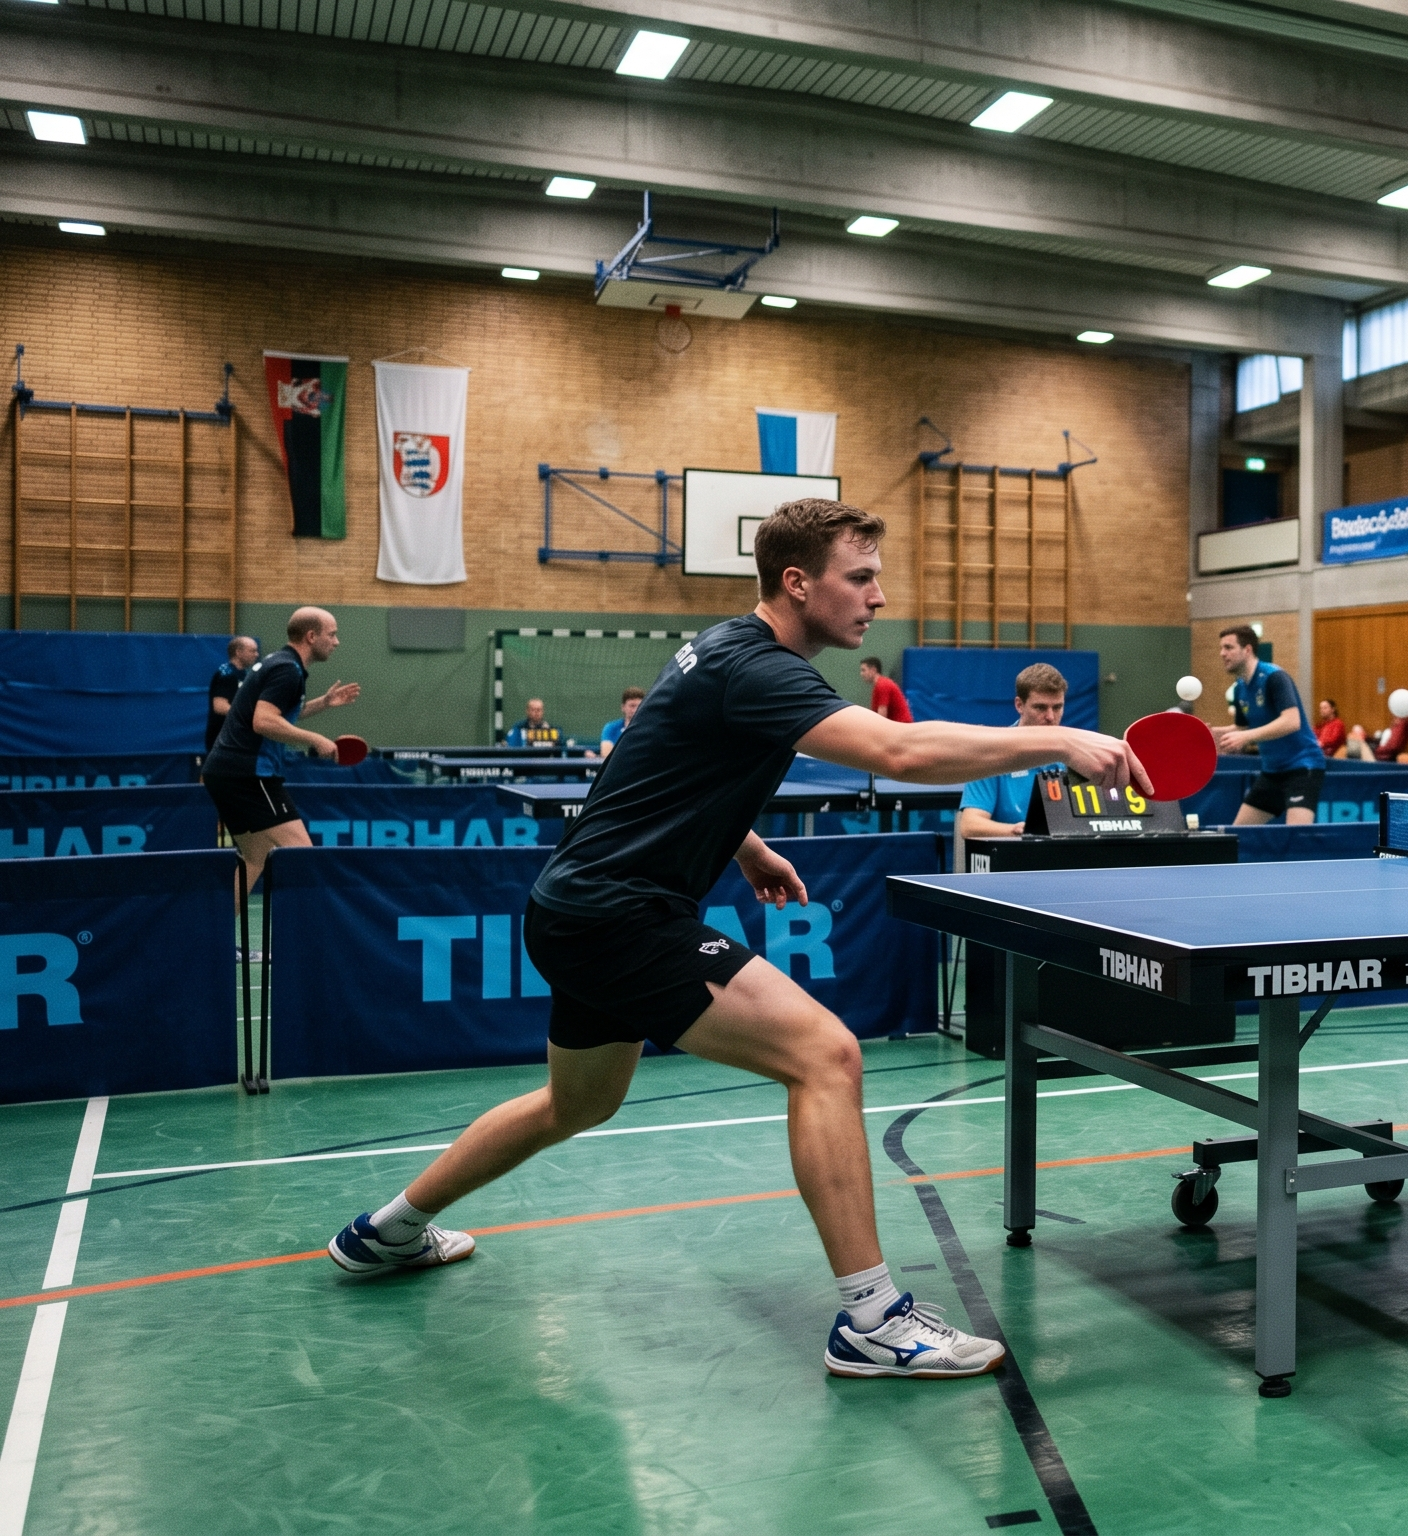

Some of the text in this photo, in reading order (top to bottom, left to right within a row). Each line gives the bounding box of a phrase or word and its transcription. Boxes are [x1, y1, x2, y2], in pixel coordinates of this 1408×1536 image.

[1071, 785, 1101, 814] 11
[1089, 820, 1143, 832] TIBHAR
[1099, 947, 1163, 993] TIBHAR
[1247, 958, 1382, 997] TIBHAR
